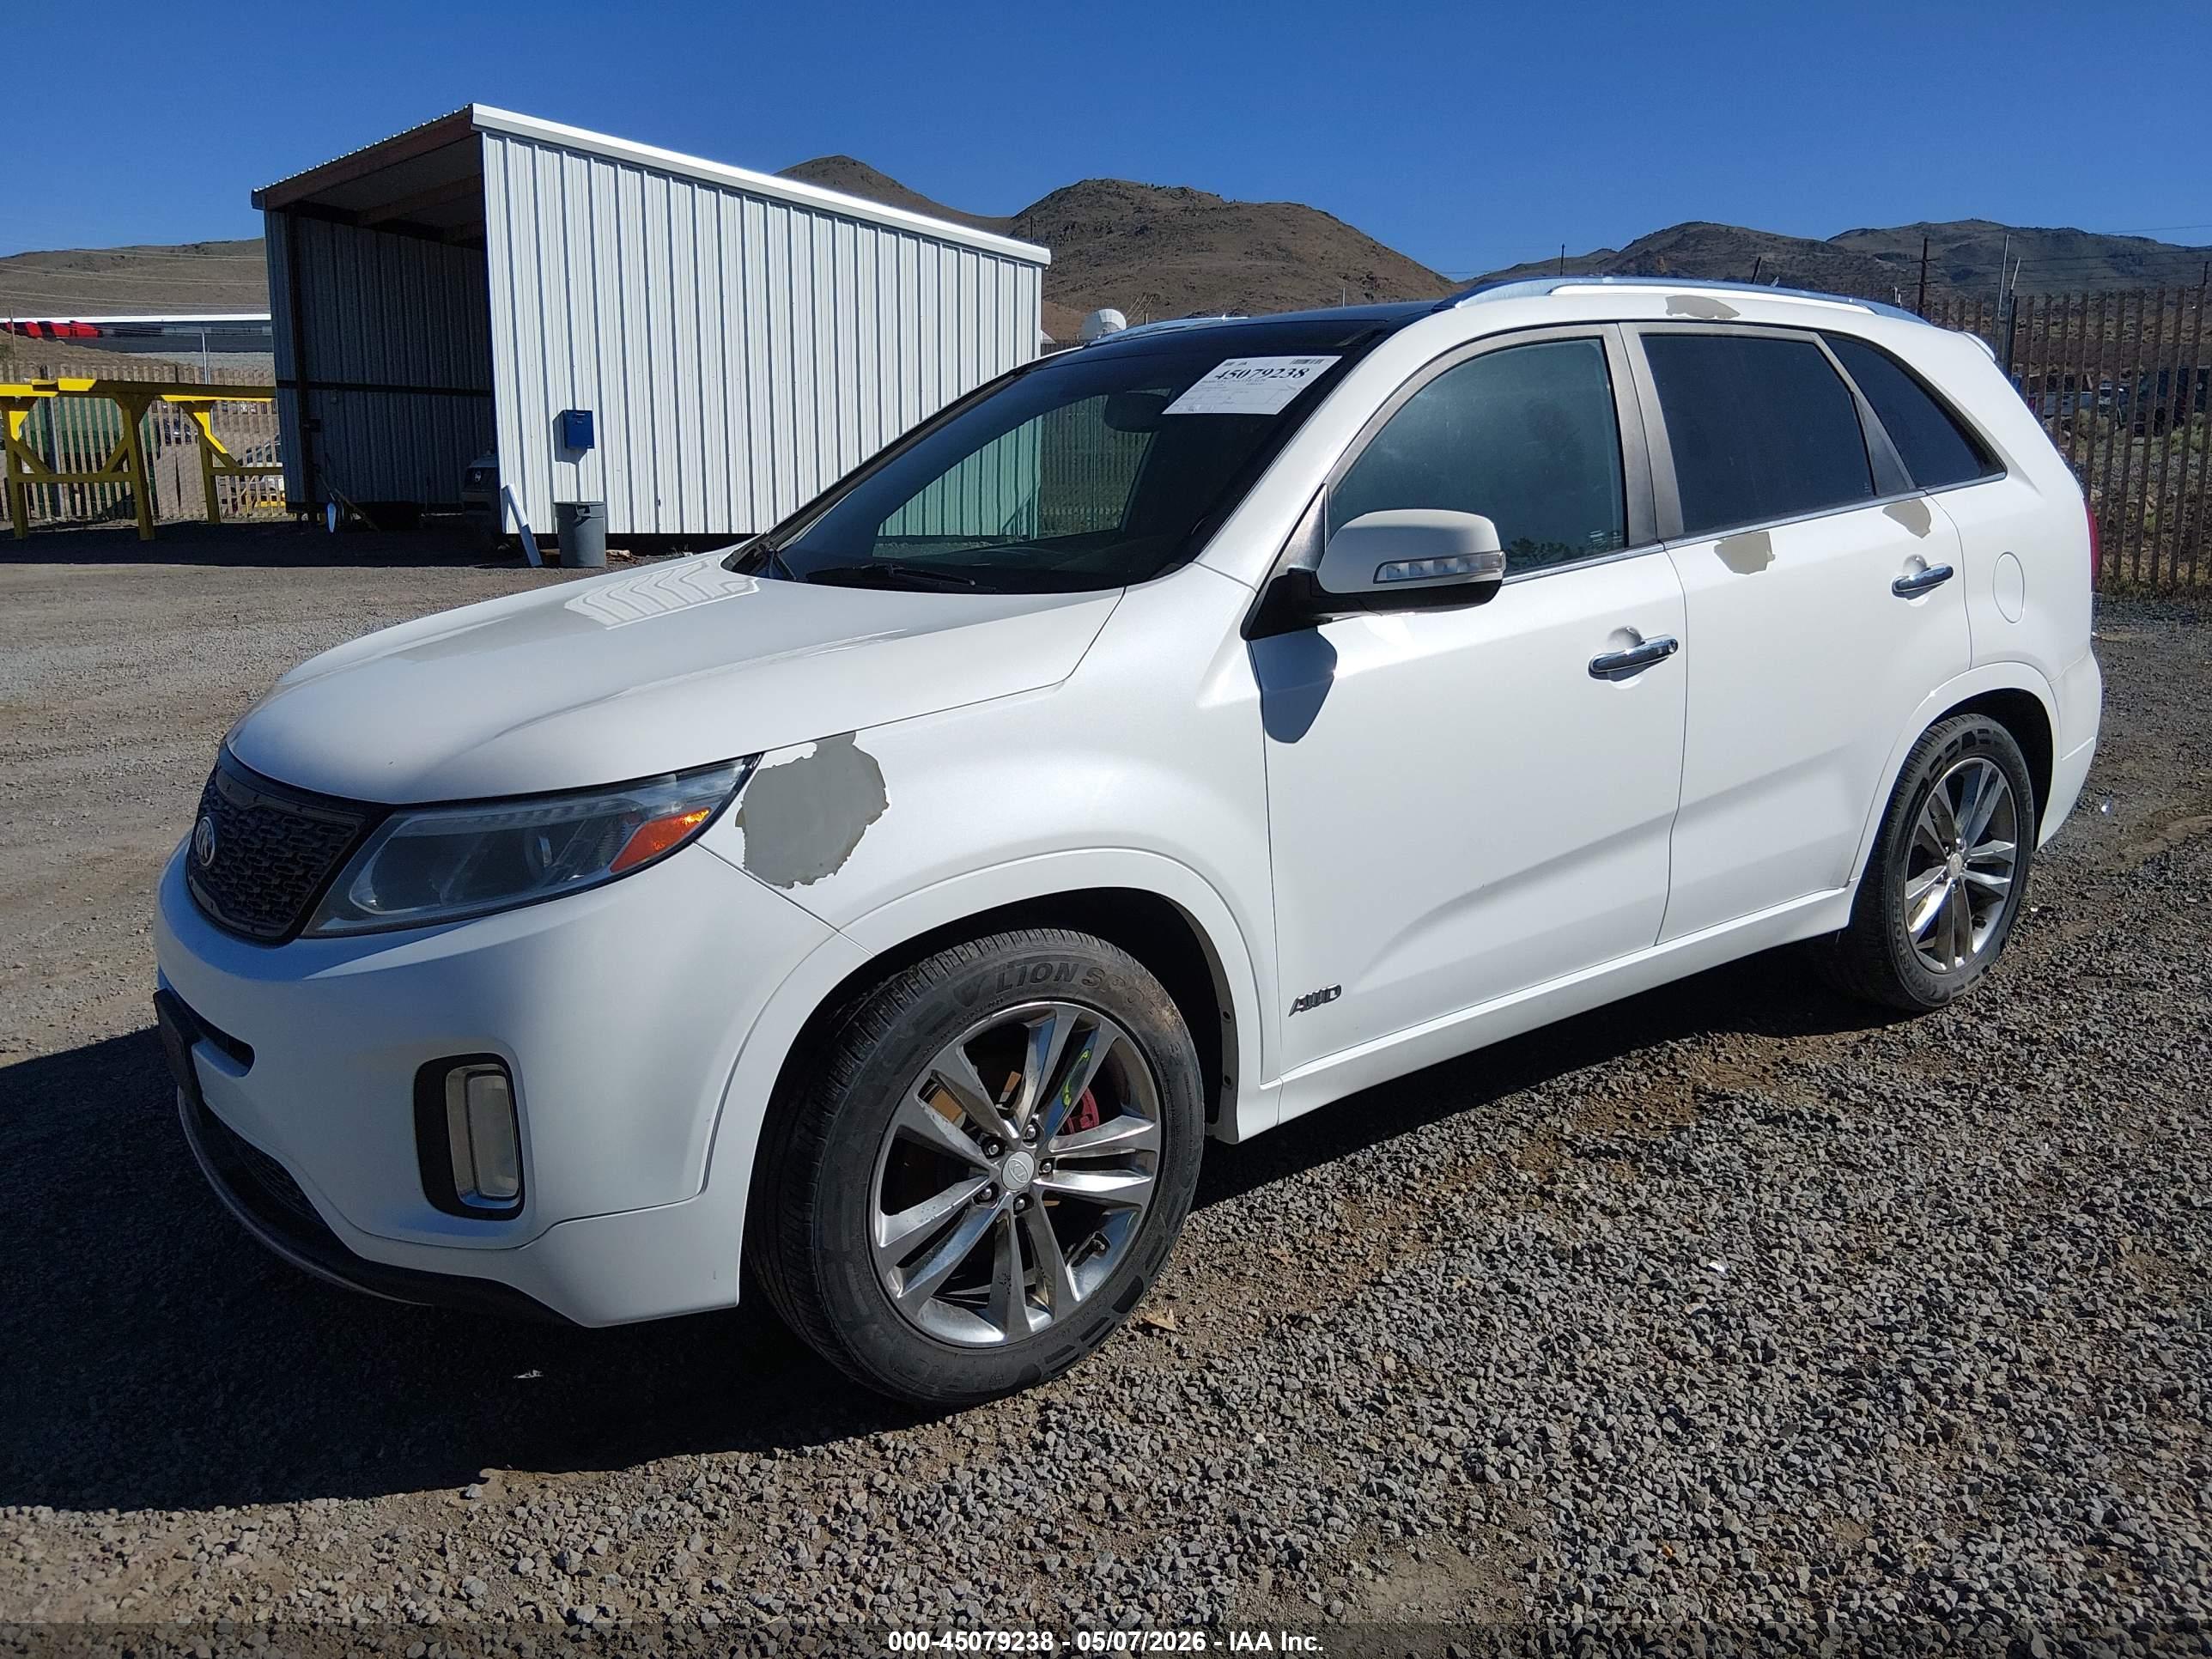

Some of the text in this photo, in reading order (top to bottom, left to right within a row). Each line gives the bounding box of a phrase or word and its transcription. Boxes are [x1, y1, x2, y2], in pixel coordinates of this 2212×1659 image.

[1214, 367, 1310, 380] 45079238
[995, 962, 1079, 994] LION
[1287, 983, 1342, 1018] AWD
